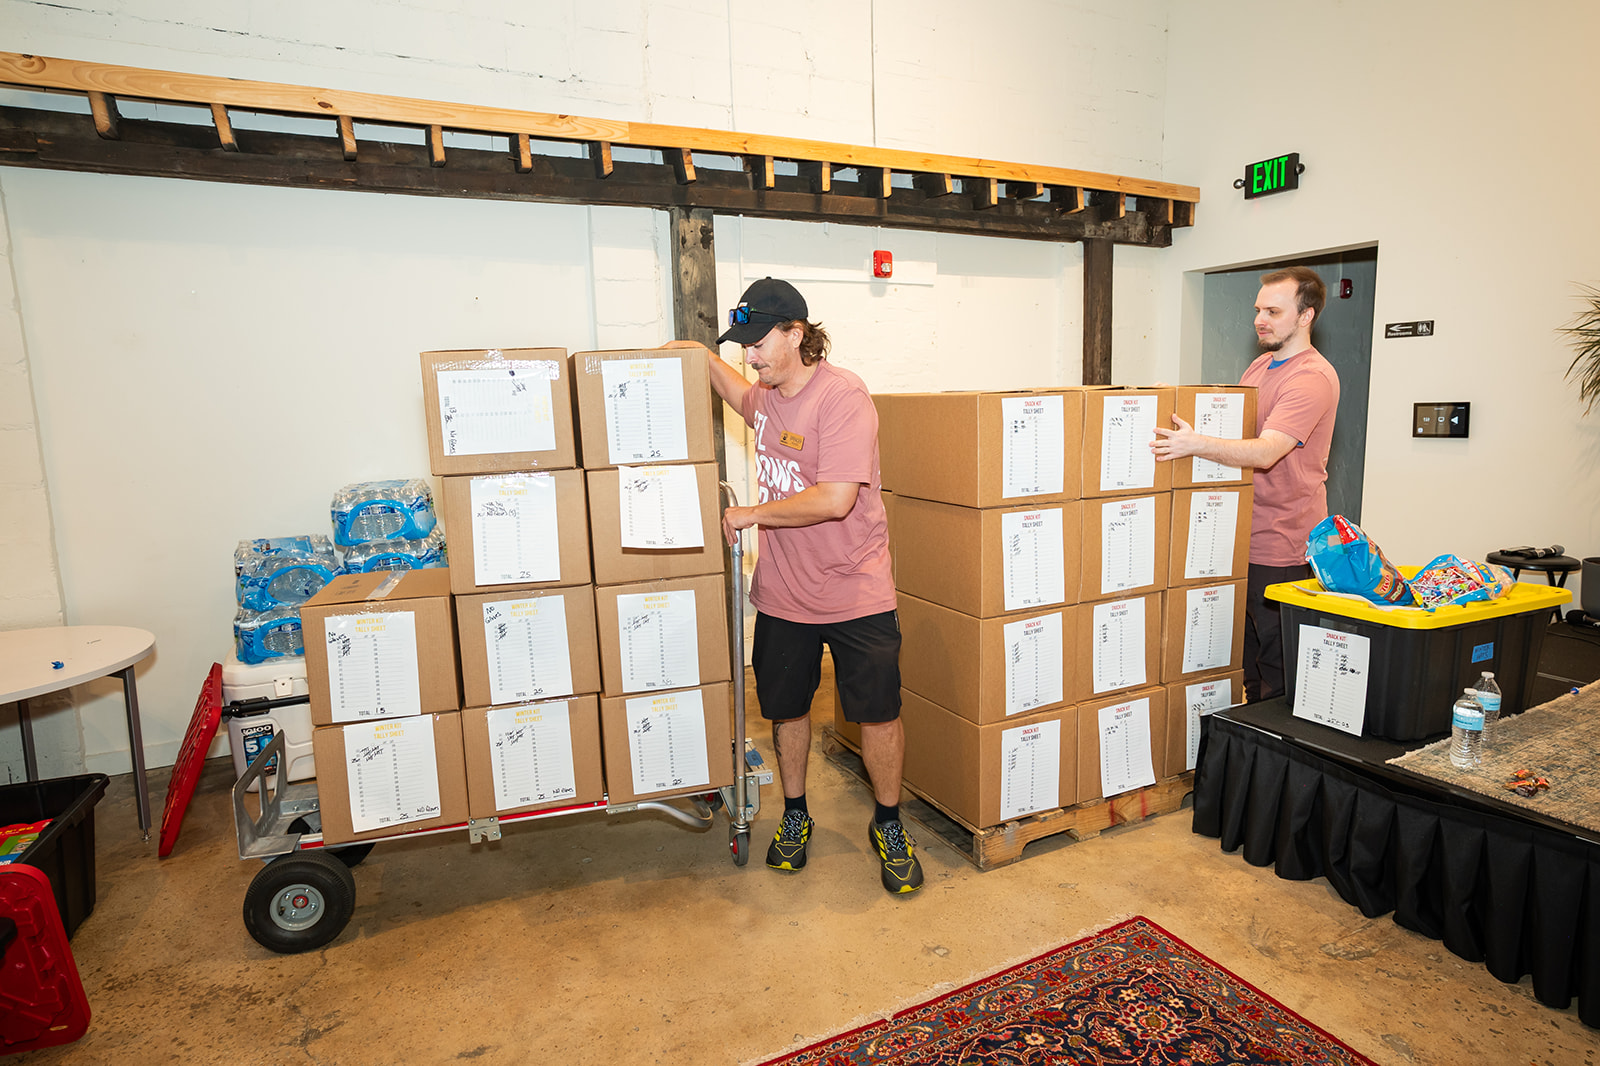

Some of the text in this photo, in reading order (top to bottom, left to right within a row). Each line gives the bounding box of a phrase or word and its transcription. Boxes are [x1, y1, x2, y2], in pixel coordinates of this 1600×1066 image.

[1252, 156, 1288, 194] EXIT
[529, 715, 542, 723] SHEET
[243, 725, 272, 734] IGLOO
[375, 724, 393, 732] WINTER
[373, 730, 404, 740] TALLY SHEET
[1031, 733, 1041, 741] SHEET
[245, 740, 258, 753] 5
